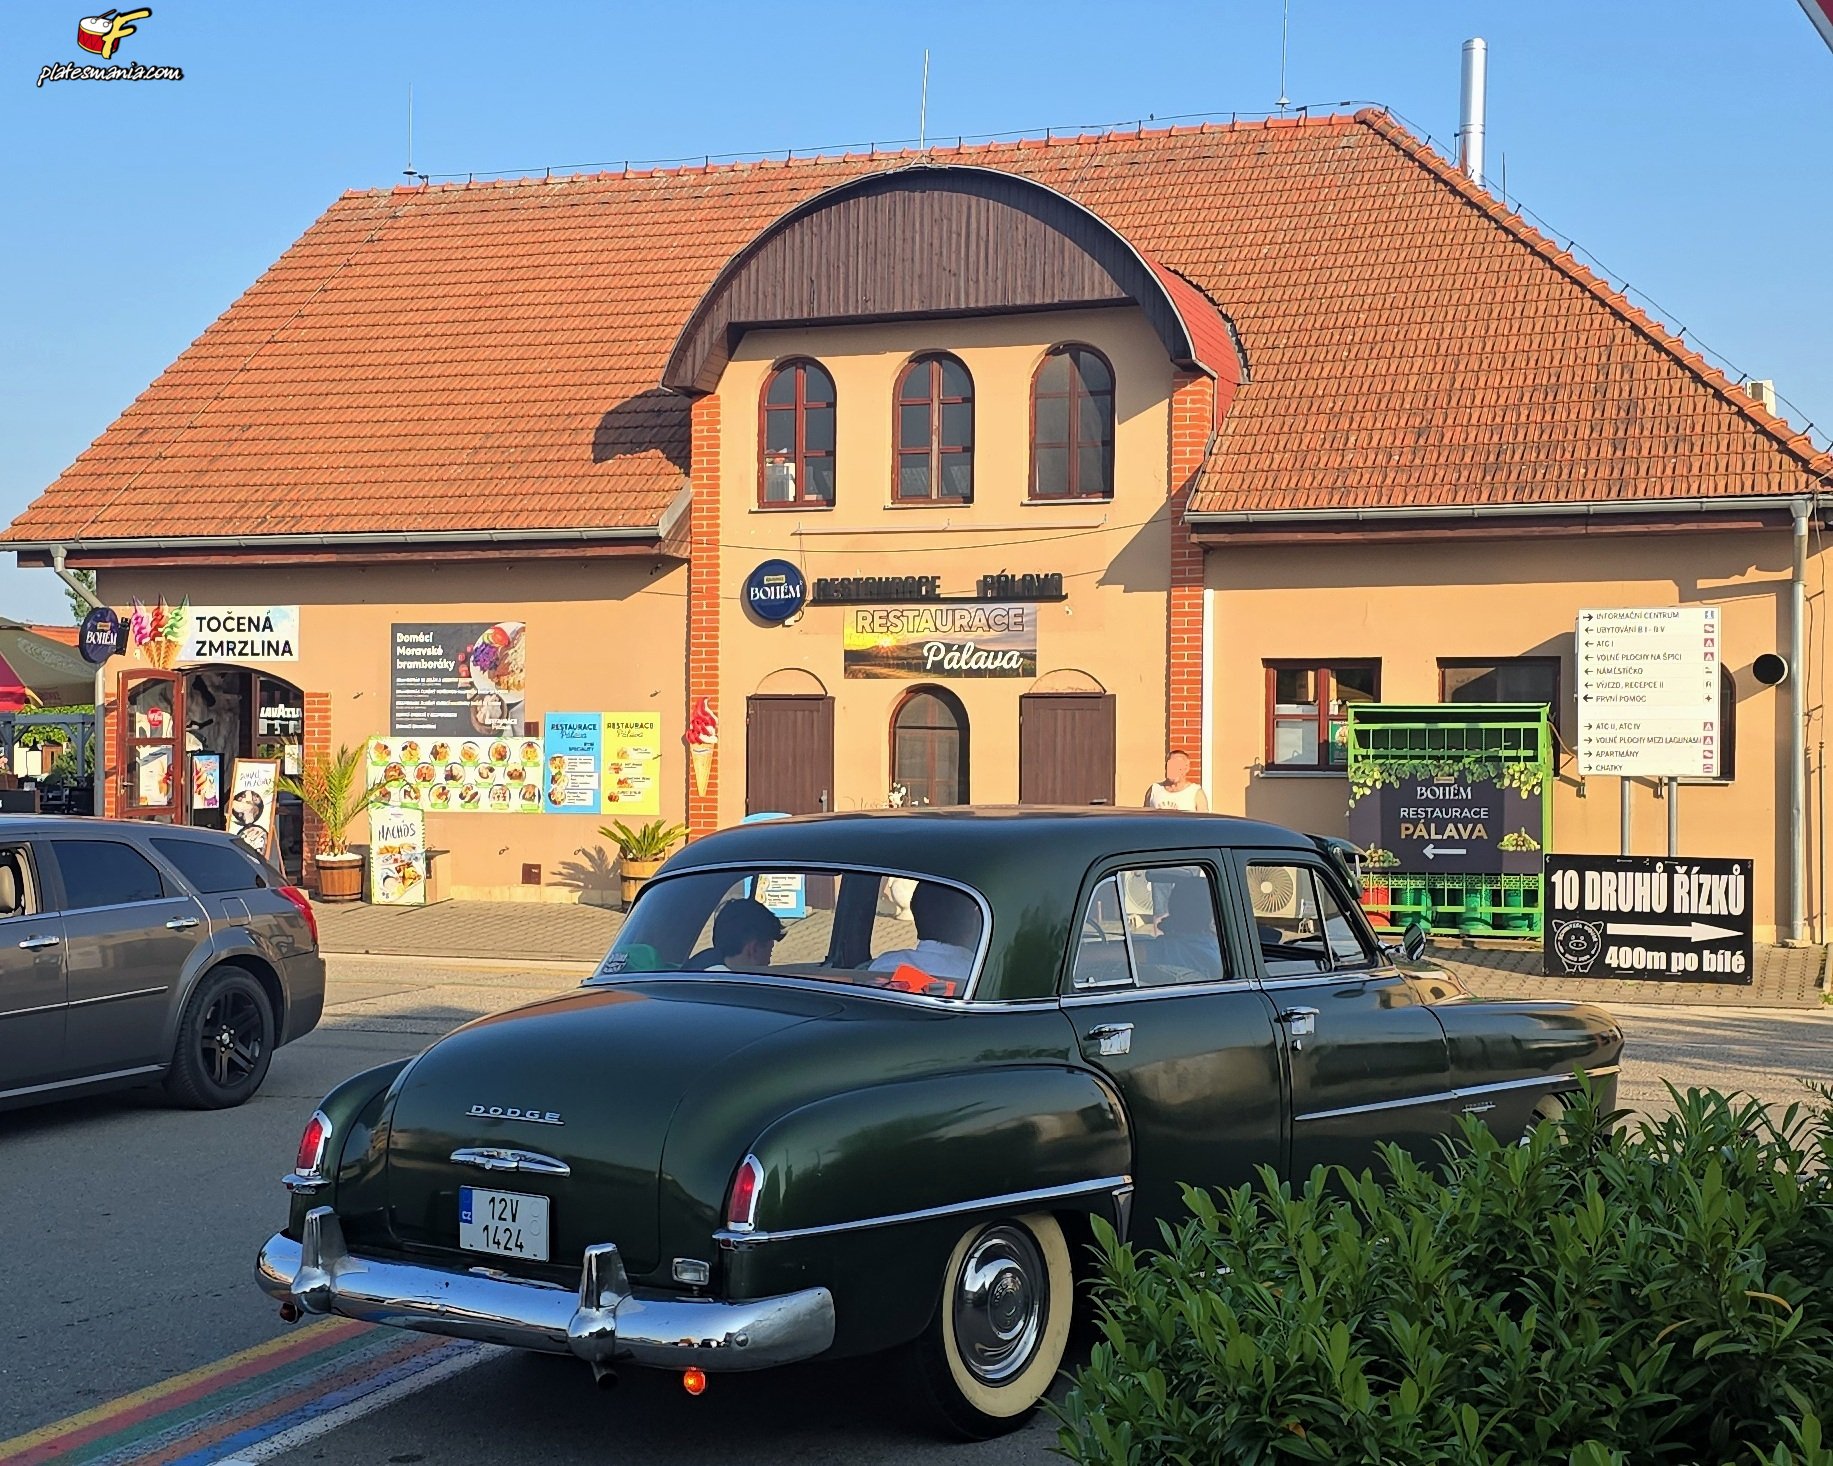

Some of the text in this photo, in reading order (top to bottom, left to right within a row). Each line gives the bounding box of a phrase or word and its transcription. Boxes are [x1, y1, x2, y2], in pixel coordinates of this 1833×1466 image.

[751, 583, 801, 600] BOHÉM
[196, 610, 275, 633] TOČENÁ
[856, 608, 1025, 634] RESTAURACE
[1596, 611, 1679, 620] INFORMAČNÍ CENTRUM
[86, 630, 118, 646] BOHÉM
[196, 640, 294, 657] ZMRZLINA
[923, 641, 1024, 671] Pálava
[396, 659, 455, 672] bramboráky
[1624, 681, 1658, 689] RECEPCE
[1619, 695, 1646, 703] POMOC
[551, 723, 597, 731] RESTAURACE
[1596, 749, 1640, 758] APARTMÁNY
[1596, 764, 1623, 772] CHATKY
[1417, 783, 1472, 800] BOHÉM
[1400, 807, 1489, 819] RESTAURACE
[1400, 818, 1488, 840] PÁLAVA
[1551, 861, 1745, 916] 10 DRUHŮ ŘÍZKŮ
[1605, 946, 1746, 974] 400m po bílé
[471, 1104, 561, 1122] DODGE
[489, 1196, 520, 1223] 12V
[483, 1224, 524, 1253] 1424
